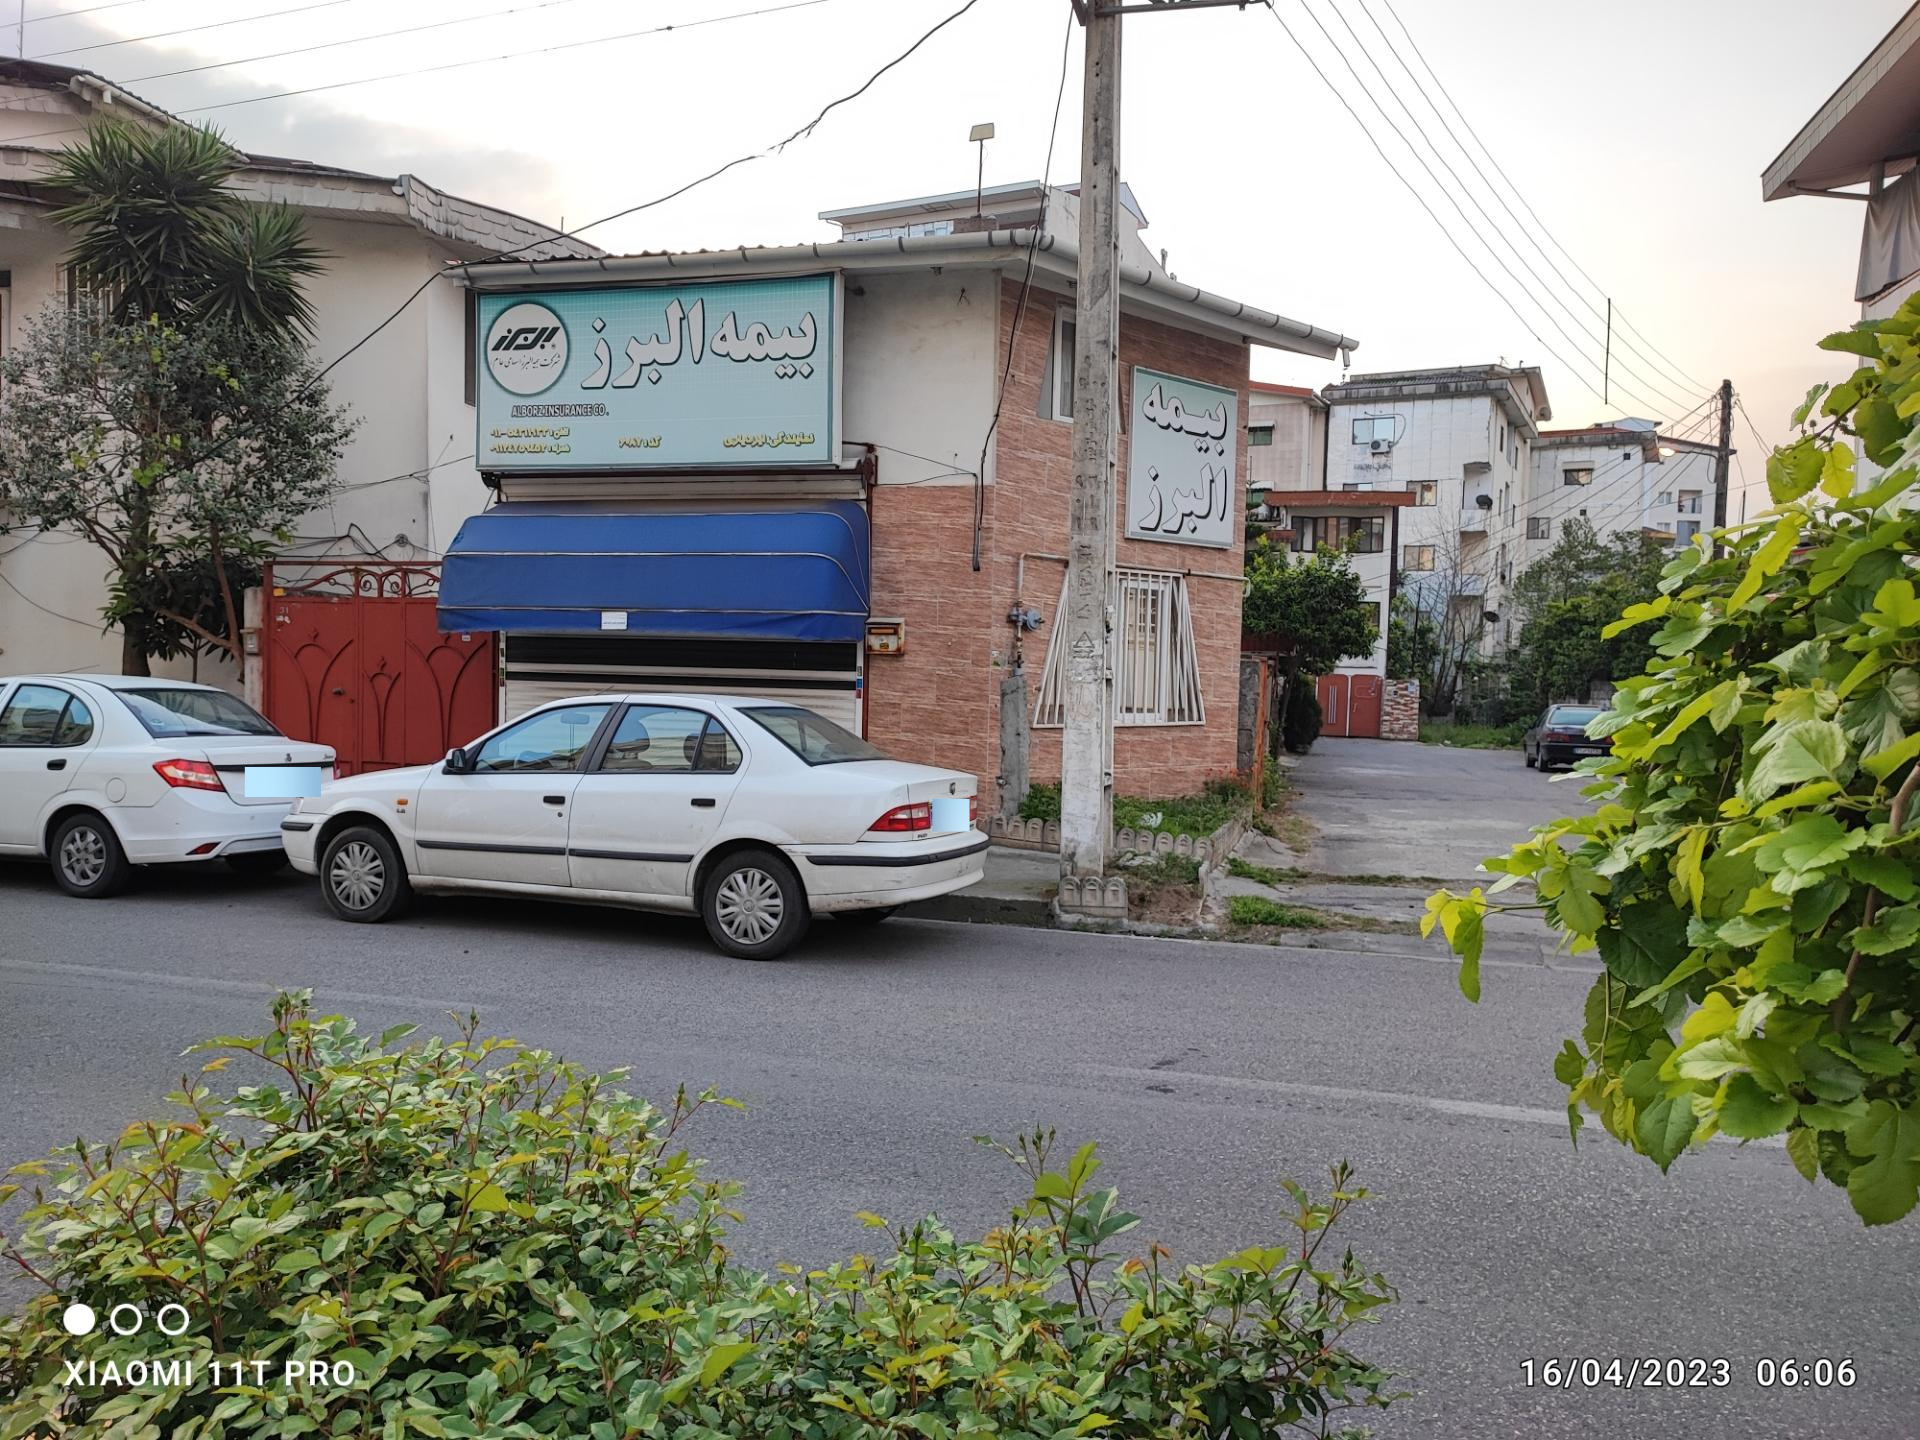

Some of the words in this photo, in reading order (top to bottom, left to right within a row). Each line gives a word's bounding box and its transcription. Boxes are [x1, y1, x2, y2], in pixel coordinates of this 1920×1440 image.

[581, 297, 705, 390] البرز
[710, 311, 818, 379] بیمه
[511, 404, 545, 418] ALBORZ
[545, 403, 592, 418] INSURANCE
[593, 402, 610, 417] CO.
[1143, 382, 1228, 457] بیمه
[1138, 462, 1227, 535] البرز
